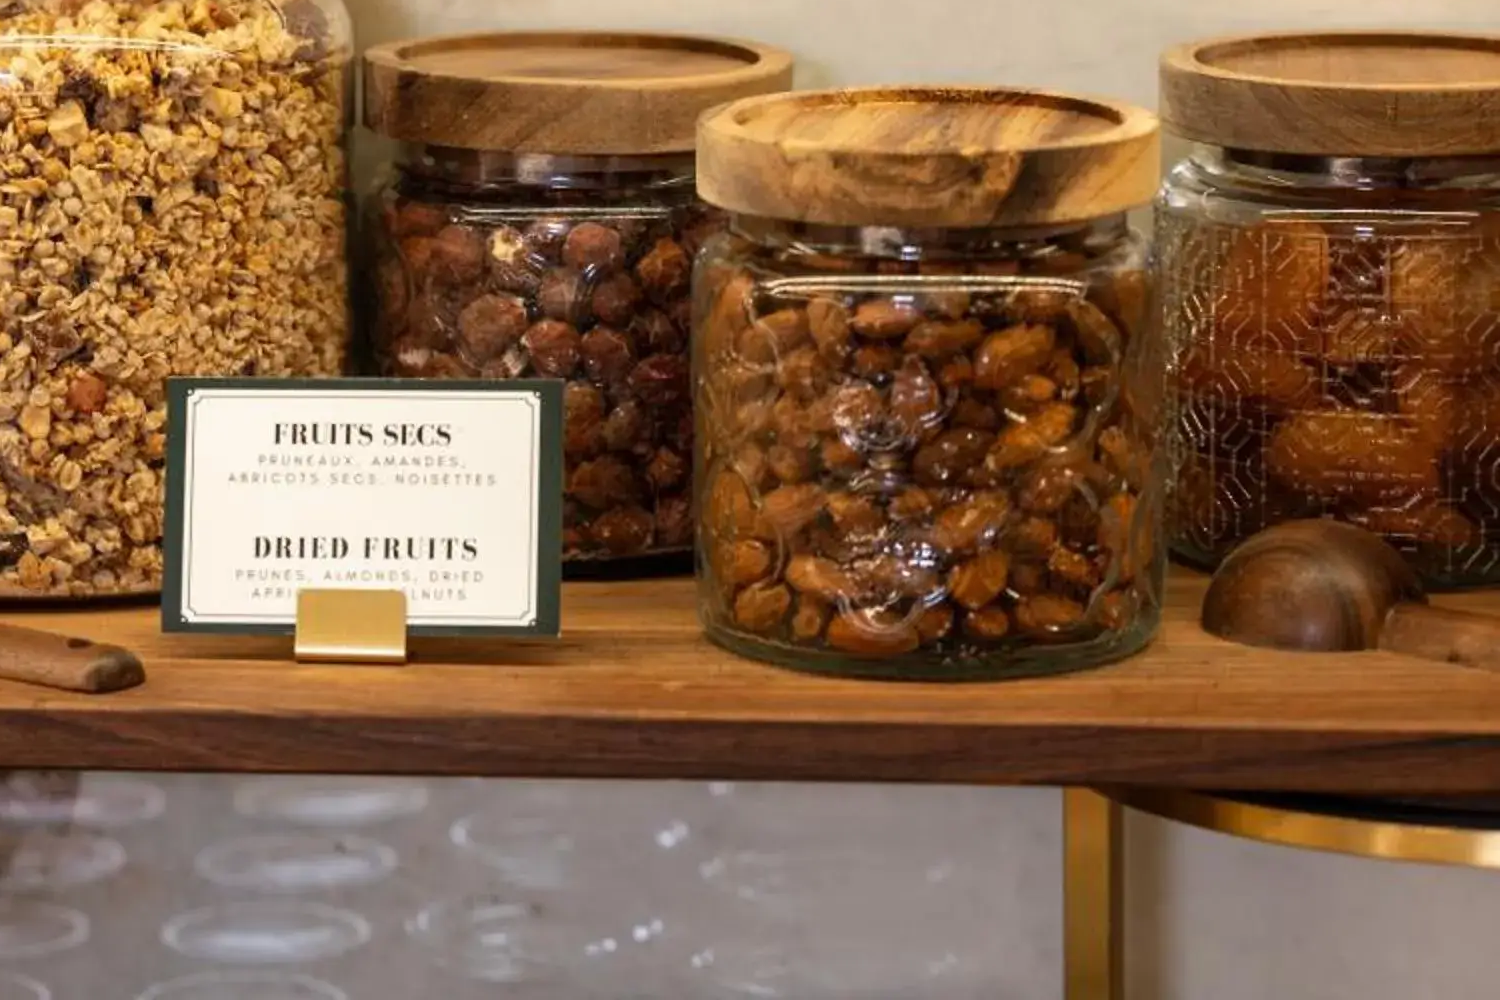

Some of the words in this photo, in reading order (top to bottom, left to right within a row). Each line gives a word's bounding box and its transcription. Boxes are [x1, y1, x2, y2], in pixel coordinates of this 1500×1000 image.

[273, 422, 373, 447] FRUITS
[383, 422, 452, 447] SECS
[370, 454, 467, 469] AMANDES,
[227, 471, 319, 486] ABRICOTS
[394, 472, 498, 487] NOISETTES
[254, 536, 349, 560] DRIED
[363, 536, 478, 561] FRUITS
[234, 568, 312, 583] PRUNES,
[322, 569, 418, 584] ALMONDS,
[428, 569, 484, 583] DRIED
